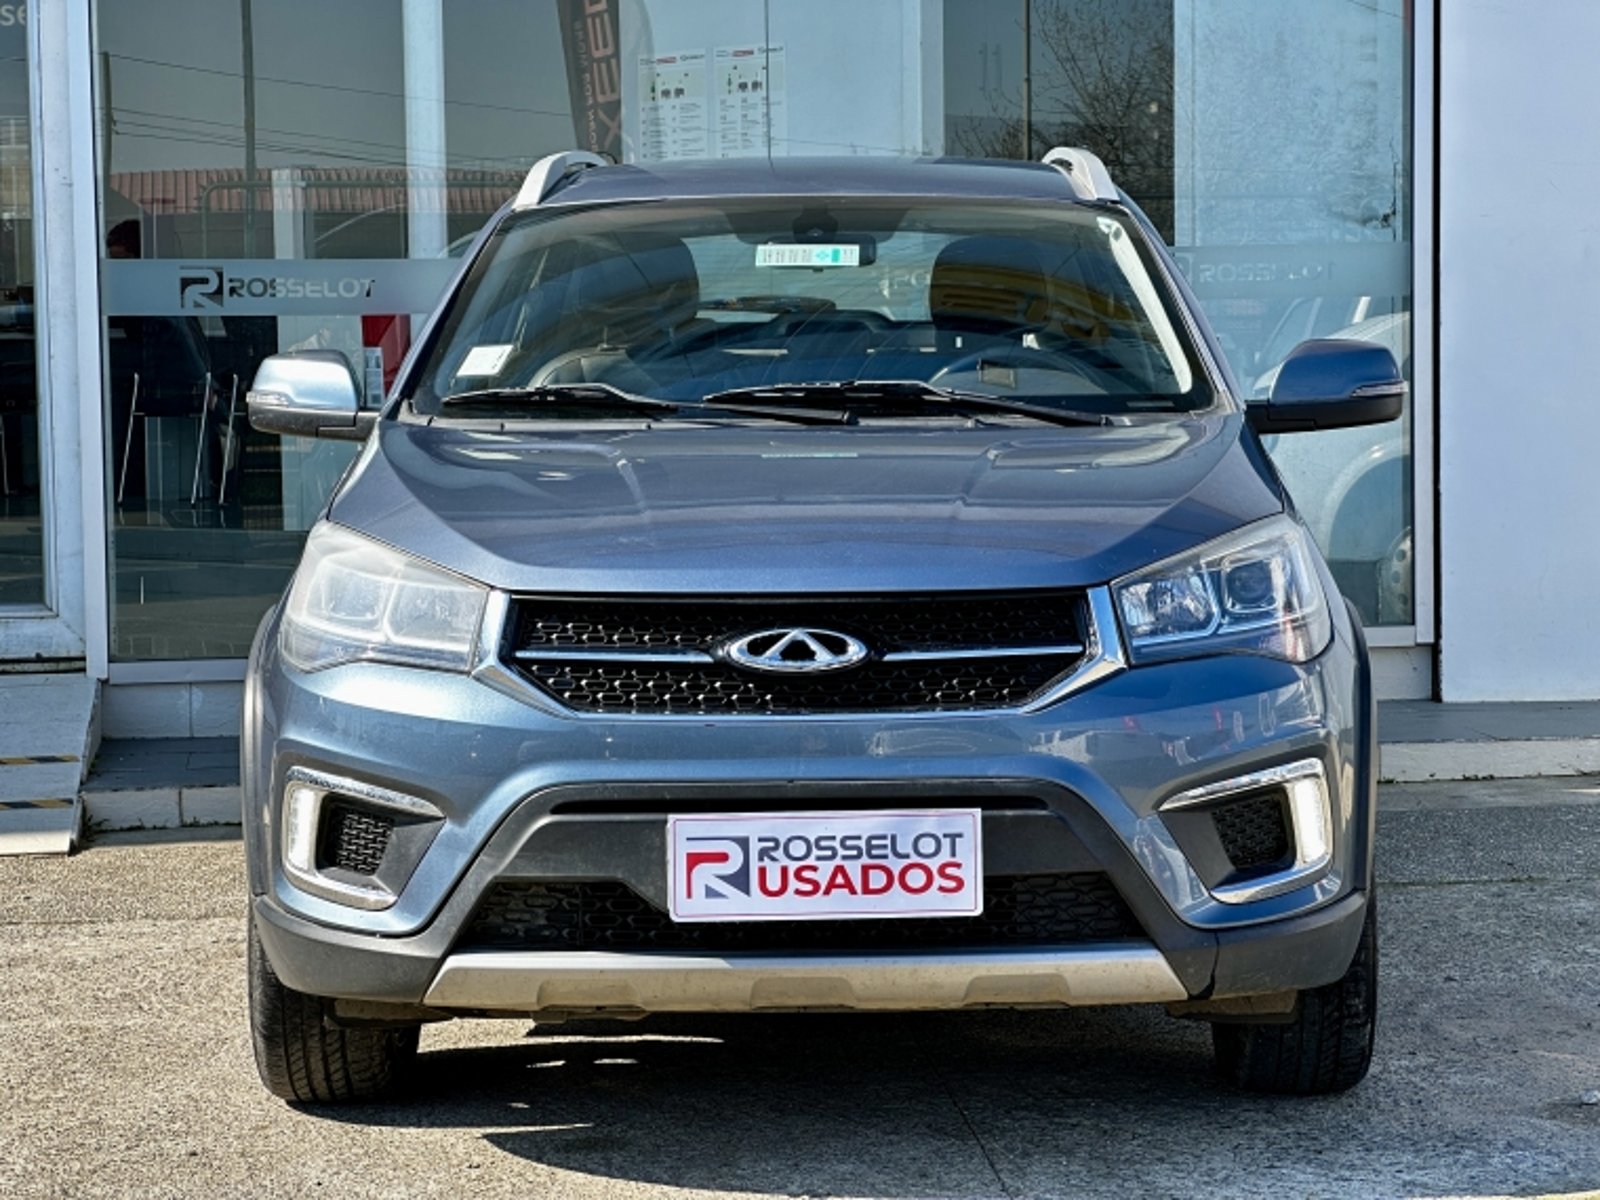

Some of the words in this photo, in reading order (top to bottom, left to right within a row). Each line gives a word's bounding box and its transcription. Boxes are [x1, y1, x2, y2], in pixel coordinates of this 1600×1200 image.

[228, 277, 376, 298] ROSSELOT
[757, 832, 964, 863] ROSSELOT
[757, 861, 966, 898] USADOS
